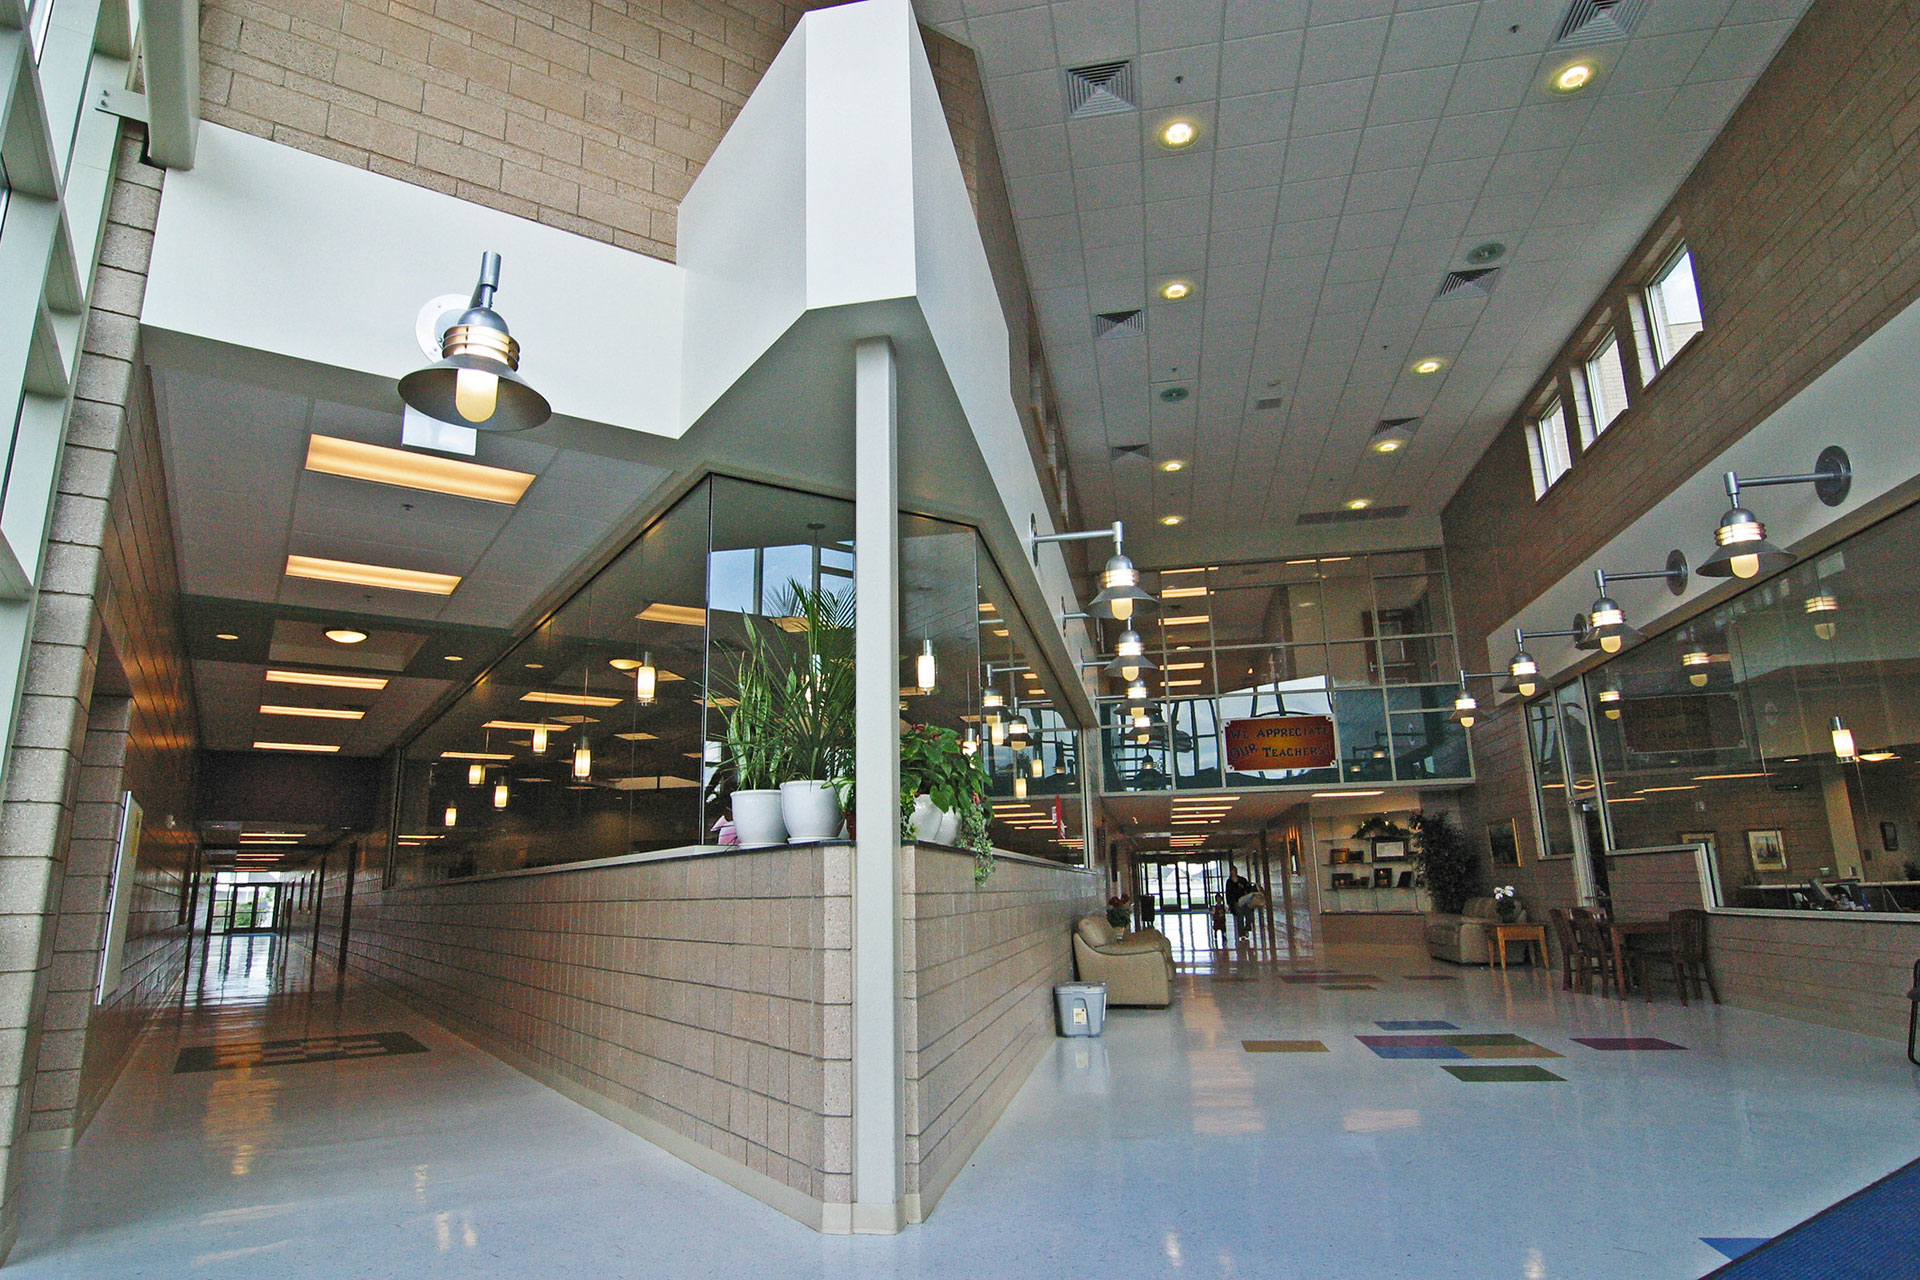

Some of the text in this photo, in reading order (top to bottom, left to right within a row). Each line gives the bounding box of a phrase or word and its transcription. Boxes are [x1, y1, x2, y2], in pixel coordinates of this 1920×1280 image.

[1230, 726, 1330, 739] WE APPRECIATE
[1230, 743, 1257, 759] OUR
